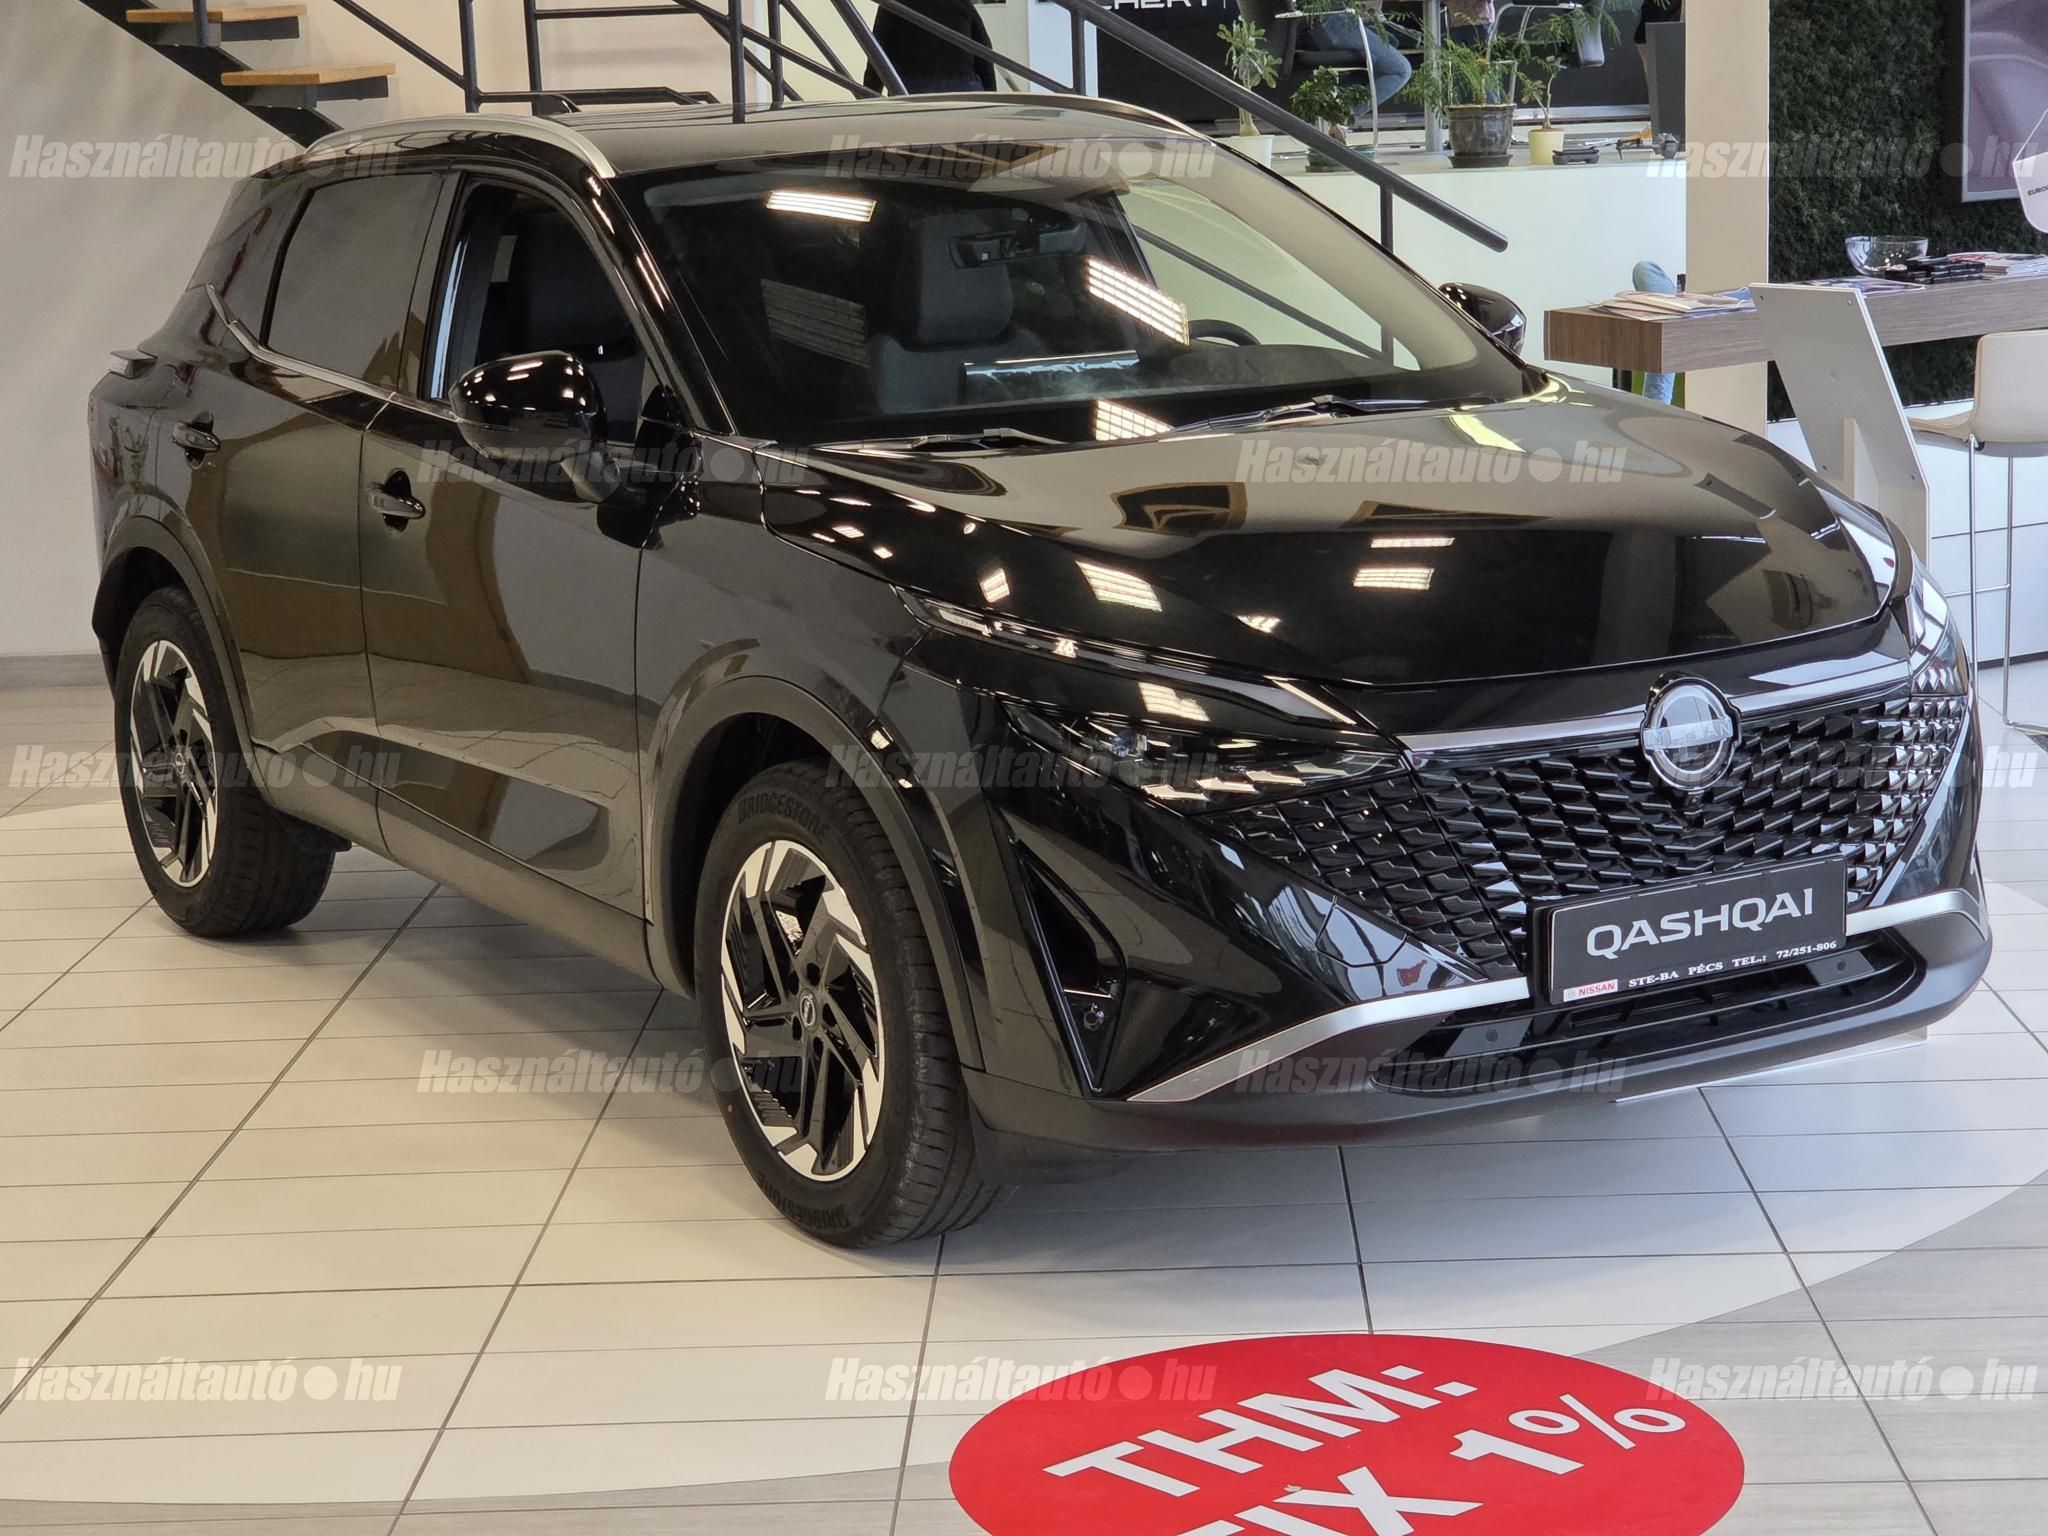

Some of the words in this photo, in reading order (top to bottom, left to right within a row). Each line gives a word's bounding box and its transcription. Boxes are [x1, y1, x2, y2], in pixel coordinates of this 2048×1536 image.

[2024, 182, 2048, 196] EURO
[1645, 719, 1731, 746] NIAN
[1586, 887, 1813, 960] QASHQAI
[1628, 970, 1680, 988] STE-BA
[1687, 961, 1724, 976] PÉCS
[1775, 940, 1838, 960] 72/251-806
[1578, 980, 1616, 998] NISSAN
[1042, 1365, 1479, 1498] THM:
[1176, 1466, 1485, 1536] IX
[1449, 1393, 1687, 1475] 1%
